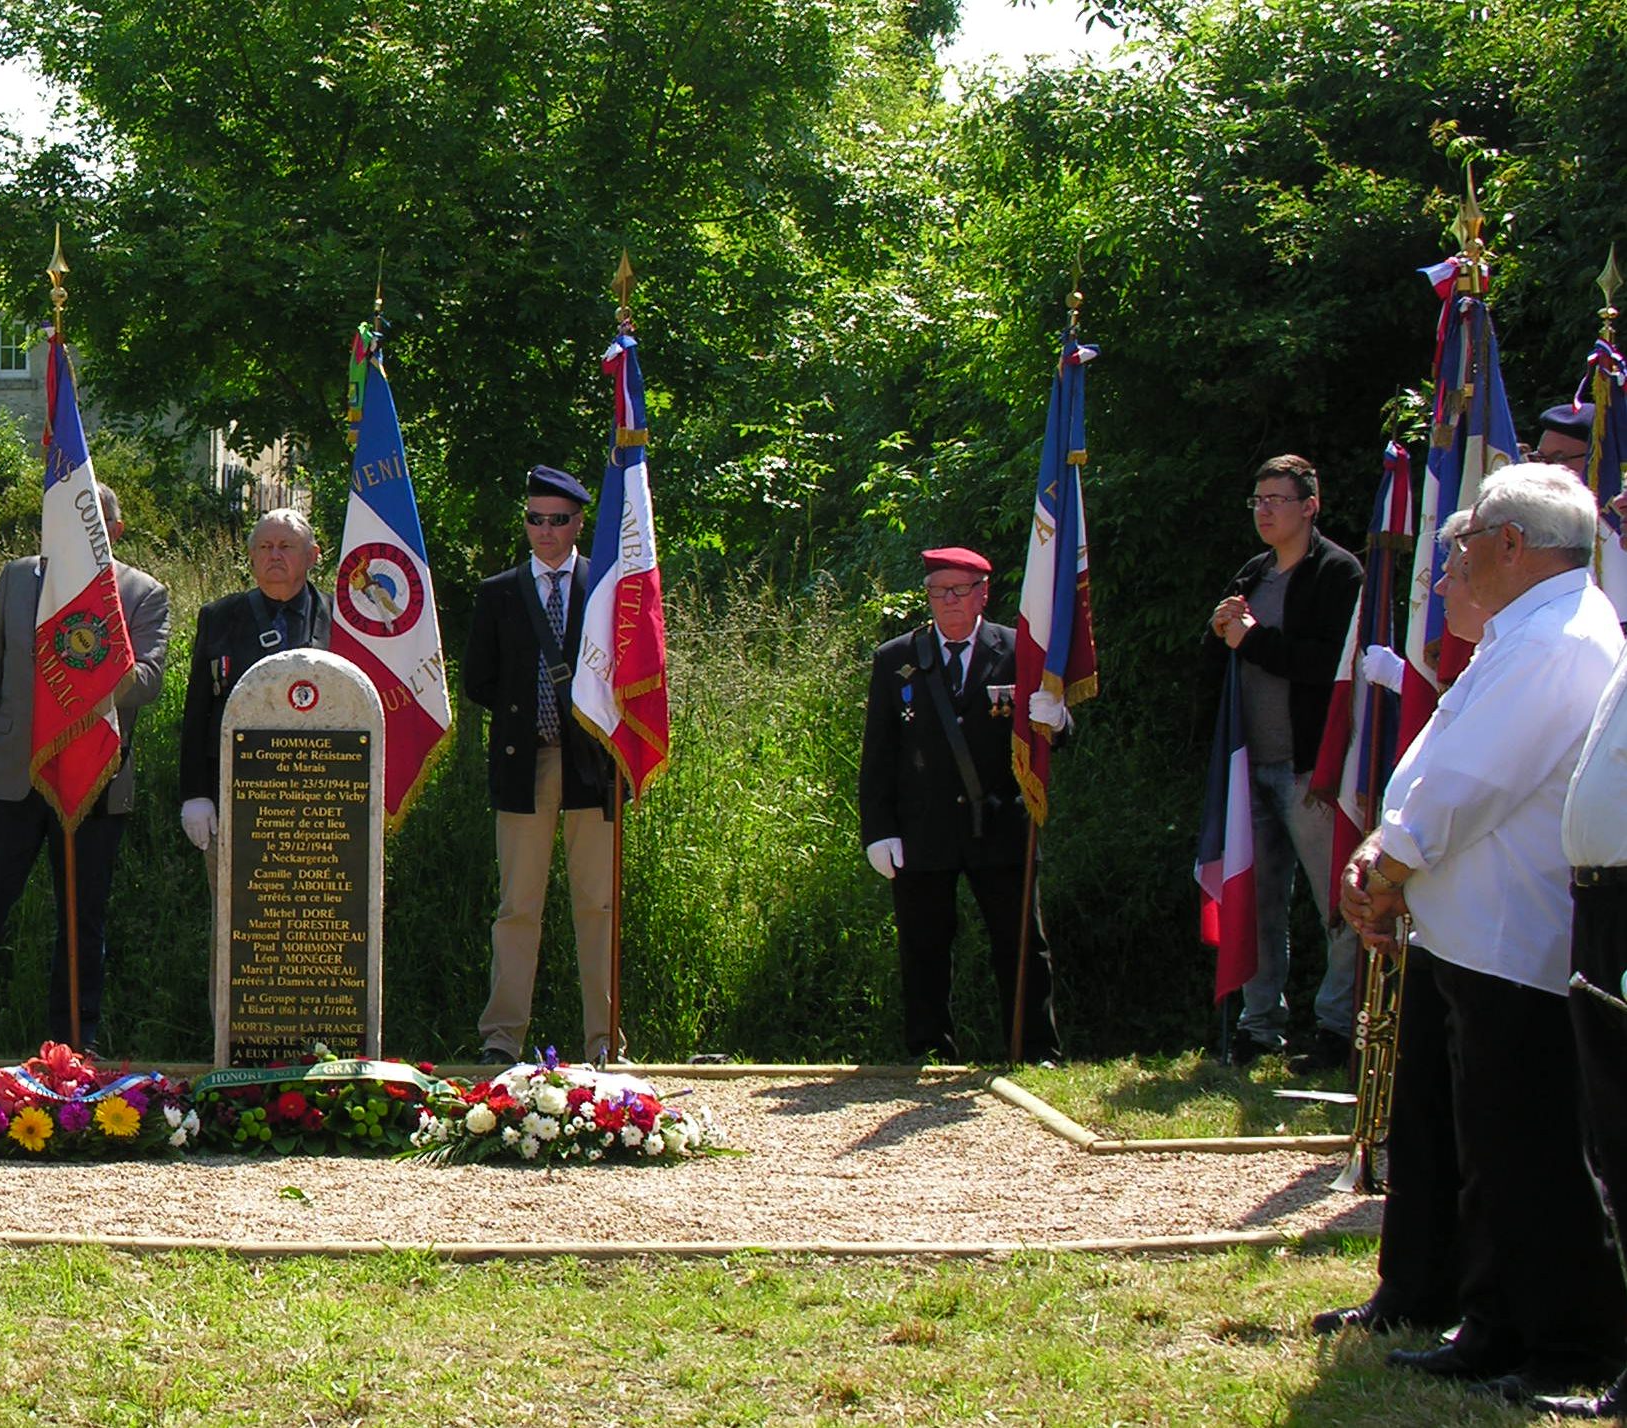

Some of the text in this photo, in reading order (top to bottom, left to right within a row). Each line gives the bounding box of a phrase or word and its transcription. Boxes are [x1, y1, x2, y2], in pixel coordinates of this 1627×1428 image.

[271, 738, 332, 748] HOMMAGE
[240, 750, 362, 761] au Groupe de Résistance
[276, 763, 326, 773] du Marais
[233, 778, 370, 793] Arrestation le 23/5/1944 par
[236, 790, 367, 804] la Police Politique de Vichy
[259, 806, 343, 817] Honoré CADET
[256, 818, 346, 829] Fermier de ce lieu
[251, 829, 350, 843] mort en déportation
[267, 841, 333, 852] le 29/12/1944
[262, 852, 339, 865] à Neckargerach
[253, 867, 346, 880] Camille DORÉ et
[247, 880, 353, 891] Jacques JABOUILLE
[257, 892, 342, 903] arrêtés en ce lieu
[263, 907, 336, 919] Michel DORÉ
[248, 919, 350, 930] Marcel FORESTIER
[233, 930, 366, 943] Raymond GIRAUDINEAU
[253, 943, 345, 953] Paul MOHIMONT
[255, 953, 343, 965] Léon MONÉGER
[241, 965, 357, 976] Marcel POUPONNEAU
[232, 975, 365, 988] arrêtés à Damvix et à Niort
[243, 992, 354, 1005] Le Groupe sera fusillé
[239, 1004, 245, 1014] à
[248, 1004, 275, 1015] Biard
[300, 1005, 309, 1015] le
[312, 1005, 357, 1016] 4/7/1944
[232, 1021, 364, 1034] MORTS pour LA FRANCE
[249, 1036, 280, 1045] NOUS
[283, 1036, 296, 1046] LE
[246, 1049, 269, 1059] EUX
